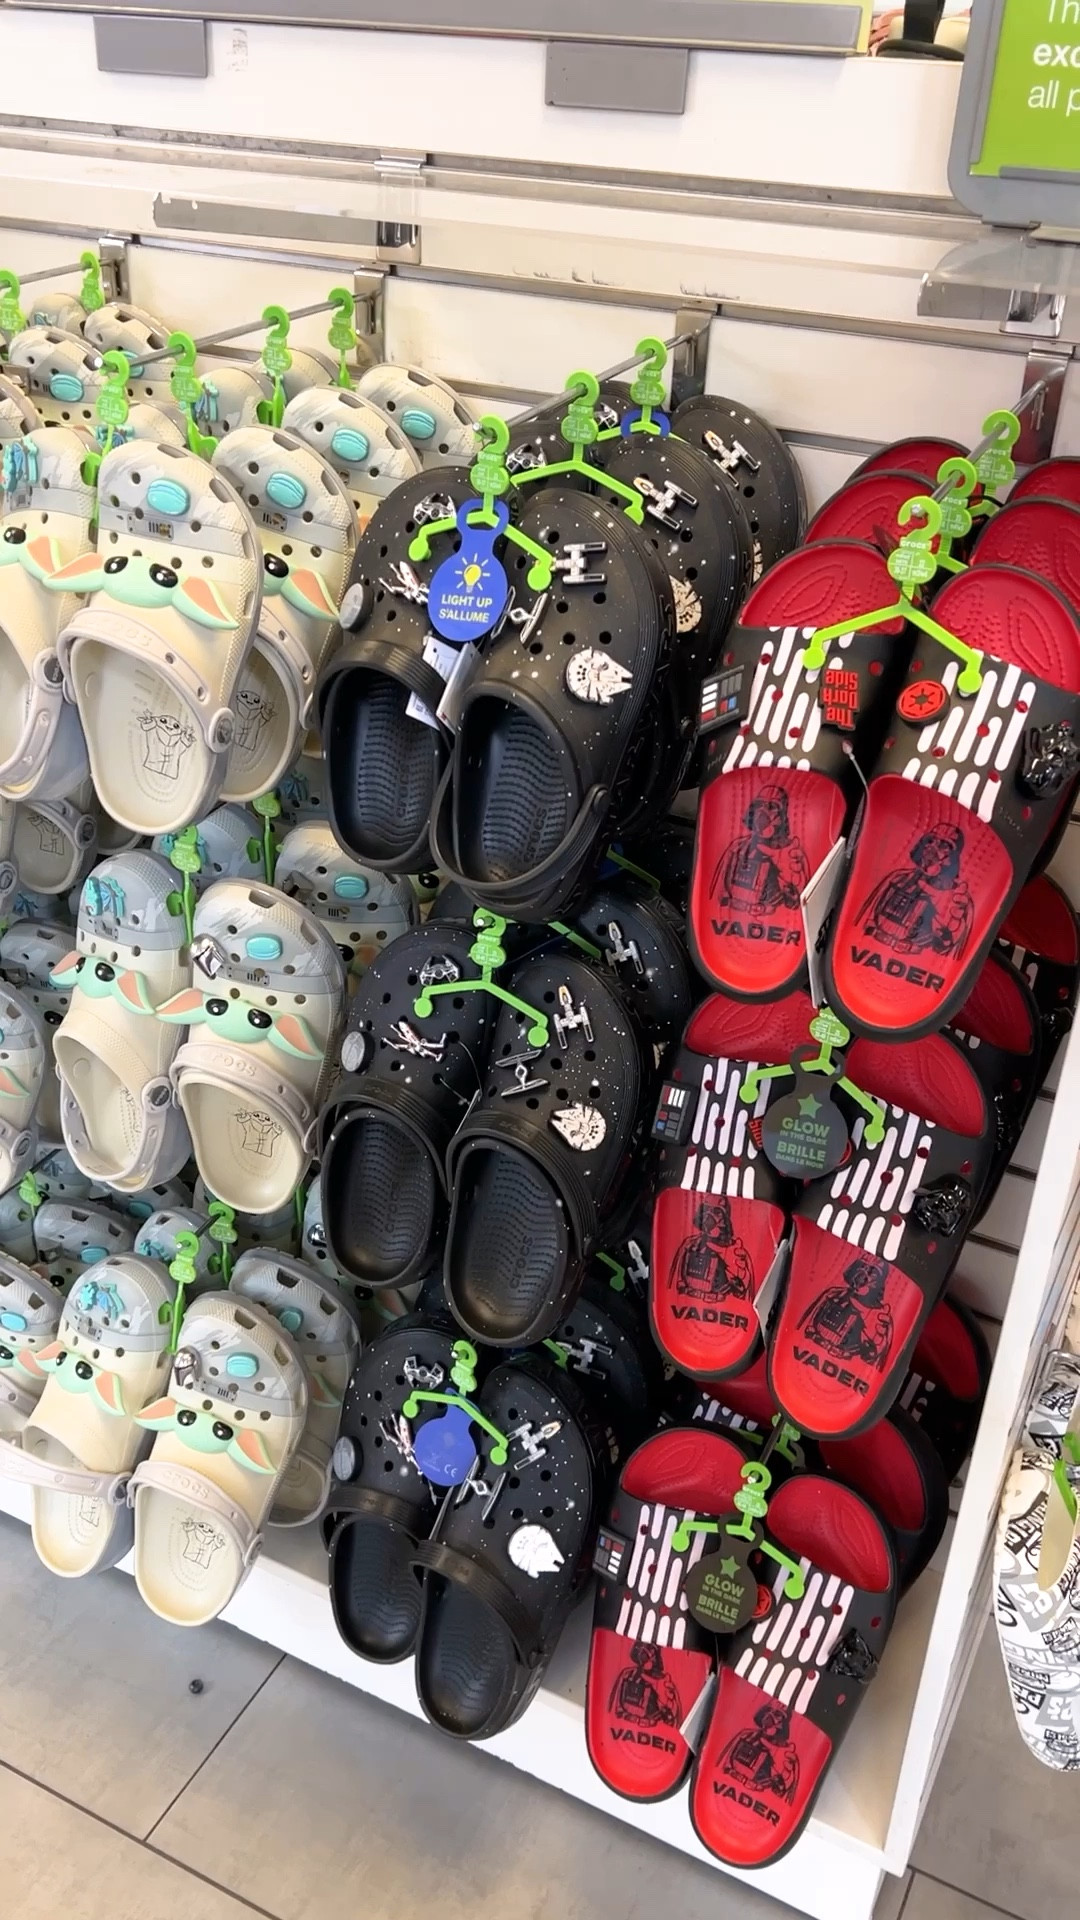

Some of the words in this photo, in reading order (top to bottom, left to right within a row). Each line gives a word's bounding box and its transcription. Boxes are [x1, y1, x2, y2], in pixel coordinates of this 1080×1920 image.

[1027, 79, 1060, 109] all
[441, 594, 474, 608] LIGHT
[478, 596, 493, 609] UP
[438, 608, 490, 623] S'ALLUME
[711, 919, 800, 946] VADER
[851, 945, 945, 993] VADER
[782, 1117, 831, 1138] GLOW
[790, 1132, 805, 1142] THE
[806, 1135, 827, 1146] DARK
[776, 1140, 827, 1162] BRILLE
[671, 1304, 748, 1332] VADER
[793, 1345, 870, 1397] VADER
[704, 1573, 745, 1598] GLOW
[710, 1586, 723, 1597] THE
[724, 1591, 741, 1605] DARK
[698, 1593, 739, 1619] BRILLE
[610, 1727, 677, 1755] VADER
[713, 1781, 781, 1827] VADER
